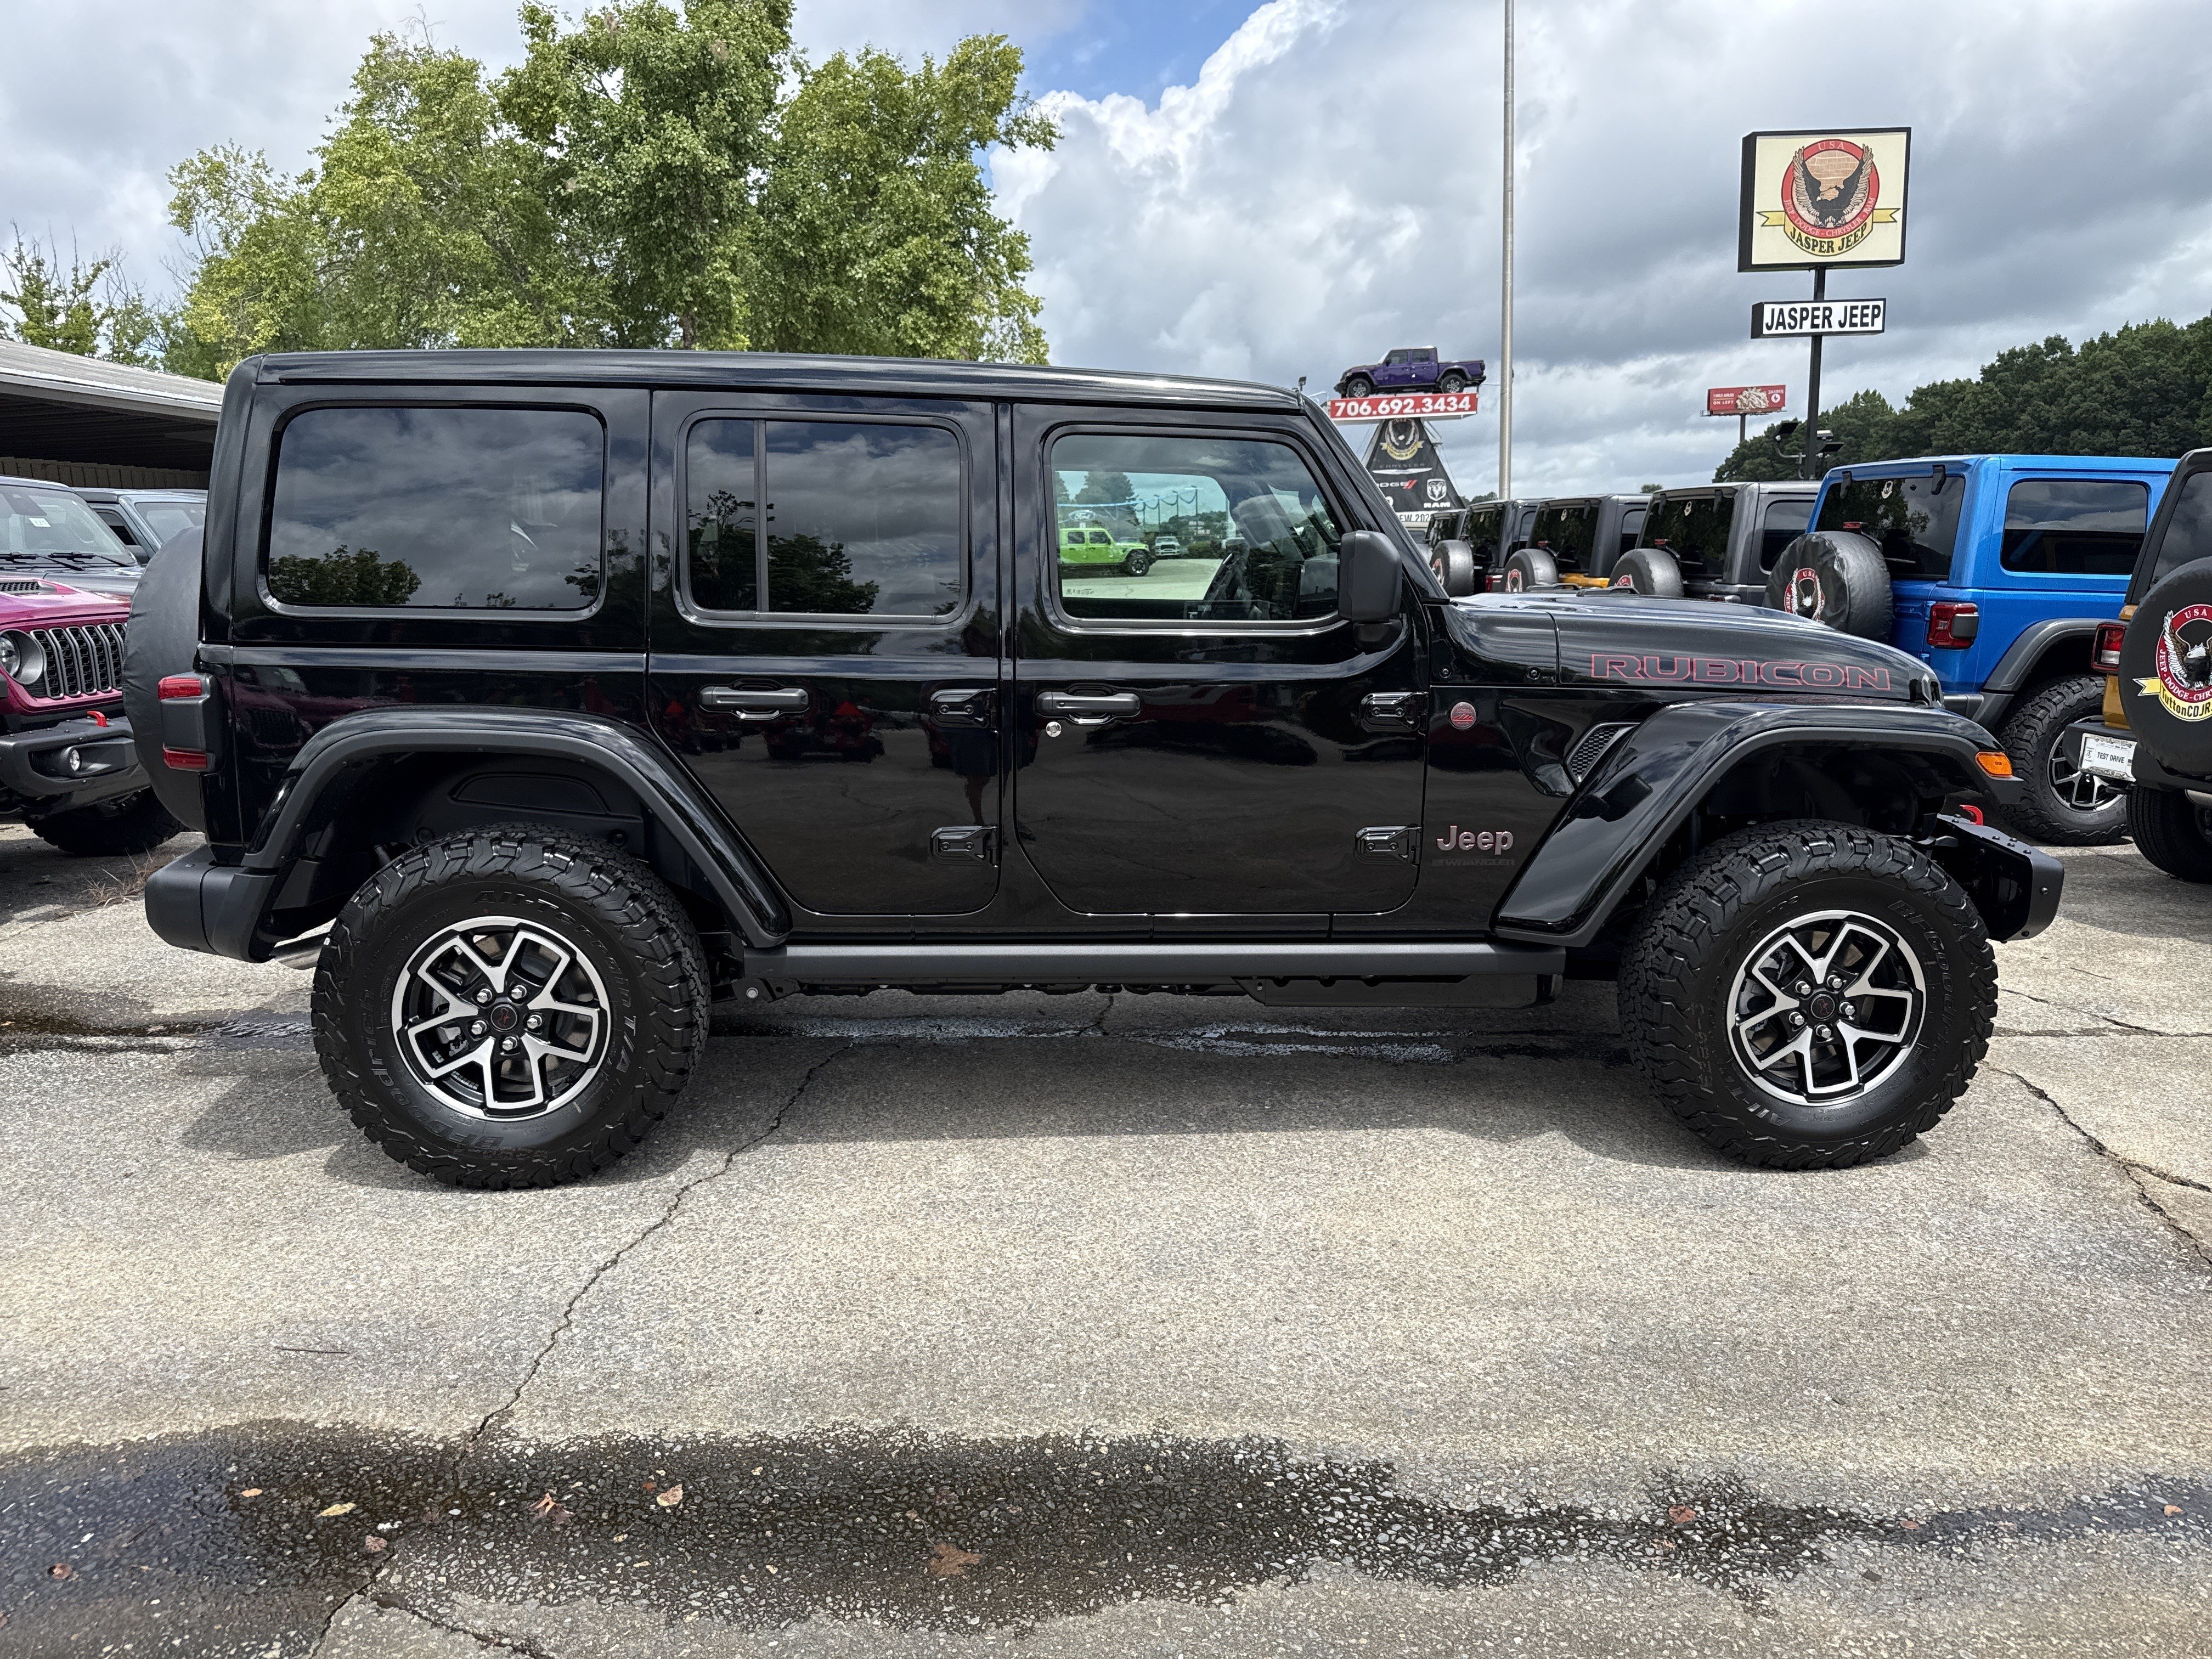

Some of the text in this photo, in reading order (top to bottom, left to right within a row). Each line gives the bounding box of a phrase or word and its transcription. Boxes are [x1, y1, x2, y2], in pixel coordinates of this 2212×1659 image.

[1818, 141, 1845, 151] USA
[1784, 197, 1876, 237] JEEP DODGE CHRYSLER RAM
[1790, 222, 1867, 253] JASPER JEEP
[1765, 304, 1881, 331] JASPER JEEP
[1334, 396, 1471, 417] 706.692.3434
[1073, 511, 1091, 521] Ford
[2184, 608, 2208, 619] USA
[1590, 654, 1891, 691] RUBICON
[2164, 676, 2190, 700] DODGE
[2097, 752, 2109, 760] TEST
[2109, 754, 2125, 764] DRIVE
[1436, 826, 1514, 855] Jeep
